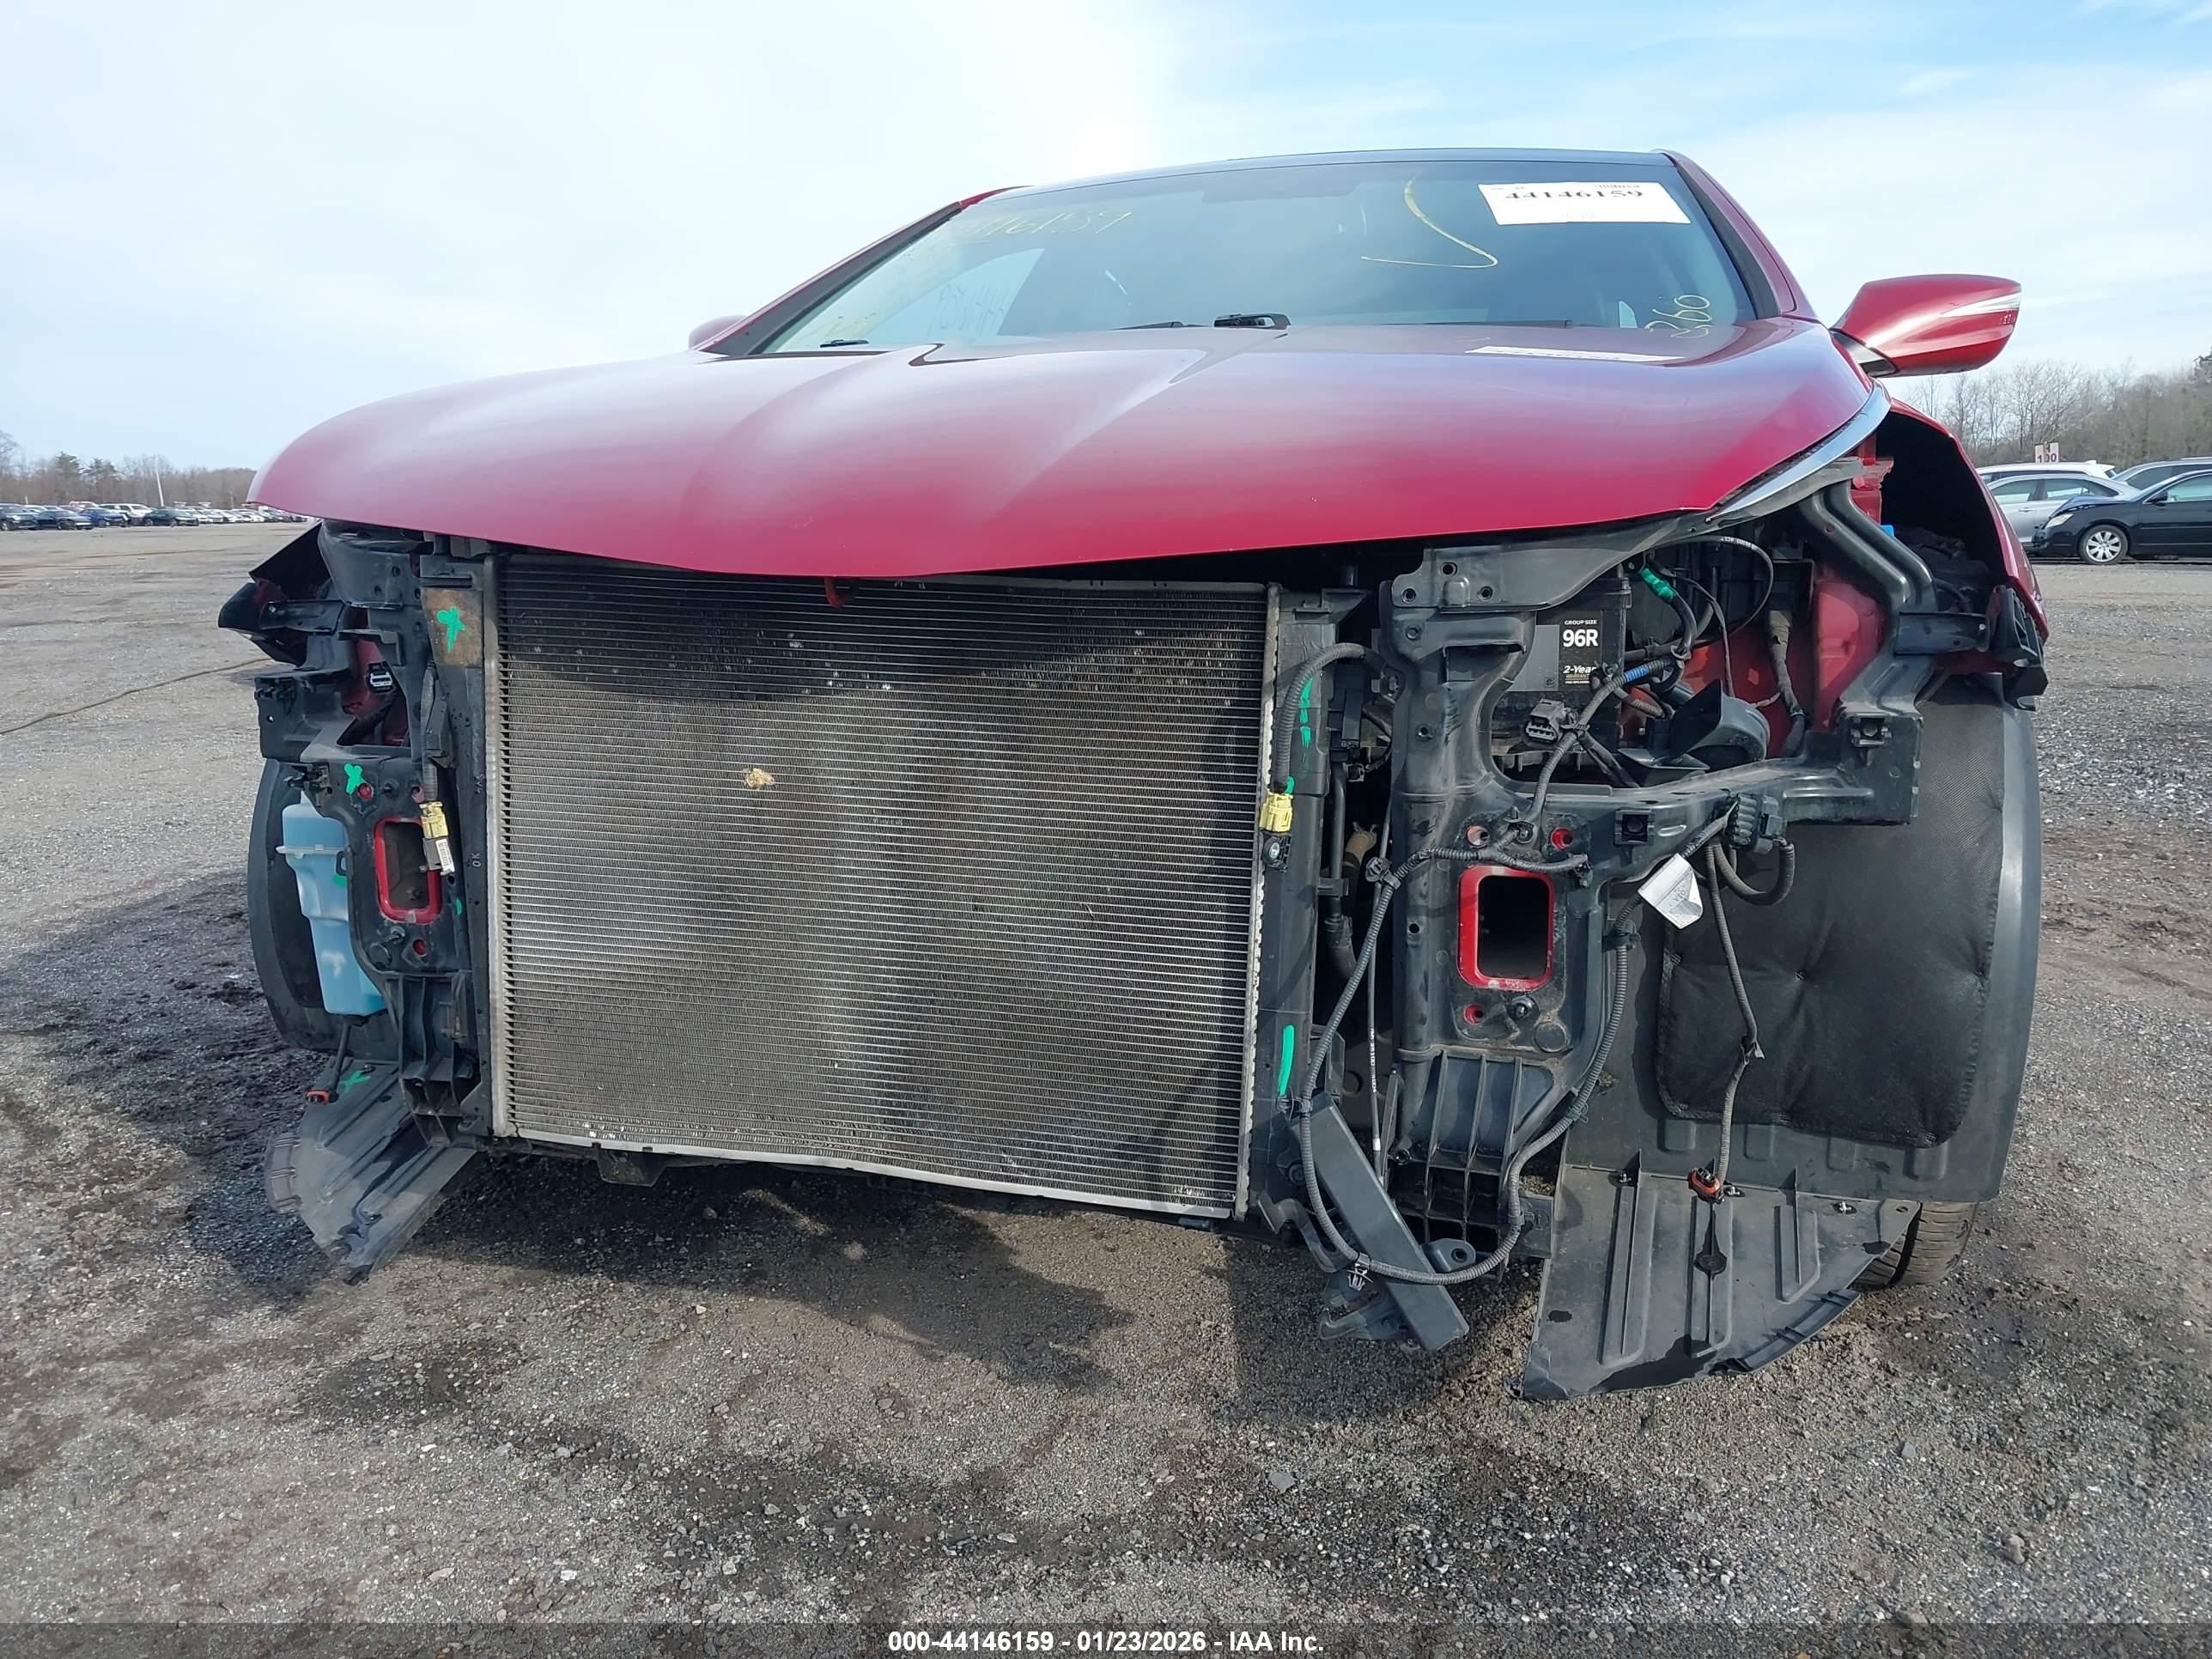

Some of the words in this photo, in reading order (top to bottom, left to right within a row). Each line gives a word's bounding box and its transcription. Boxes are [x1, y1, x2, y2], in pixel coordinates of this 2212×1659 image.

[1504, 191, 1644, 199] 44146159
[1563, 629, 1599, 647] 96R
[1563, 665, 1597, 674] 2-Year
[471, 853, 482, 867] OK
